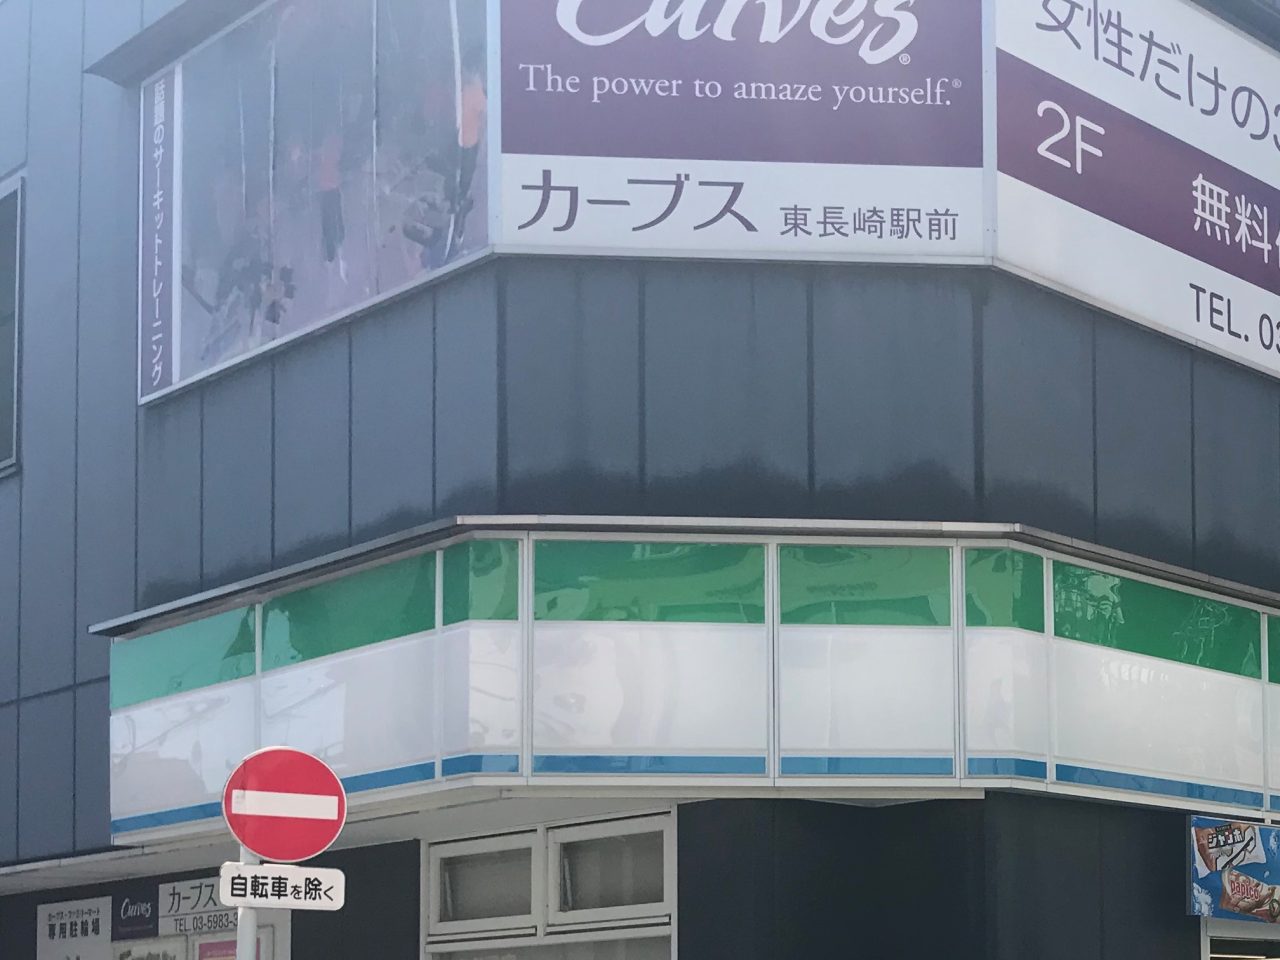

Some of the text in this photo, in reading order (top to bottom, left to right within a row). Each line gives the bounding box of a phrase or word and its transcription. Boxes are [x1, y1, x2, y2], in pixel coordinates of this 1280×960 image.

[519, 64, 580, 93] The
[592, 75, 682, 103] power
[694, 75, 722, 98] to
[734, 79, 822, 101] amaze
[1036, 100, 1106, 174] 2F
[518, 169, 959, 240] カーブス 東長崎駅前
[231, 875, 334, 901] 自転車を除く
